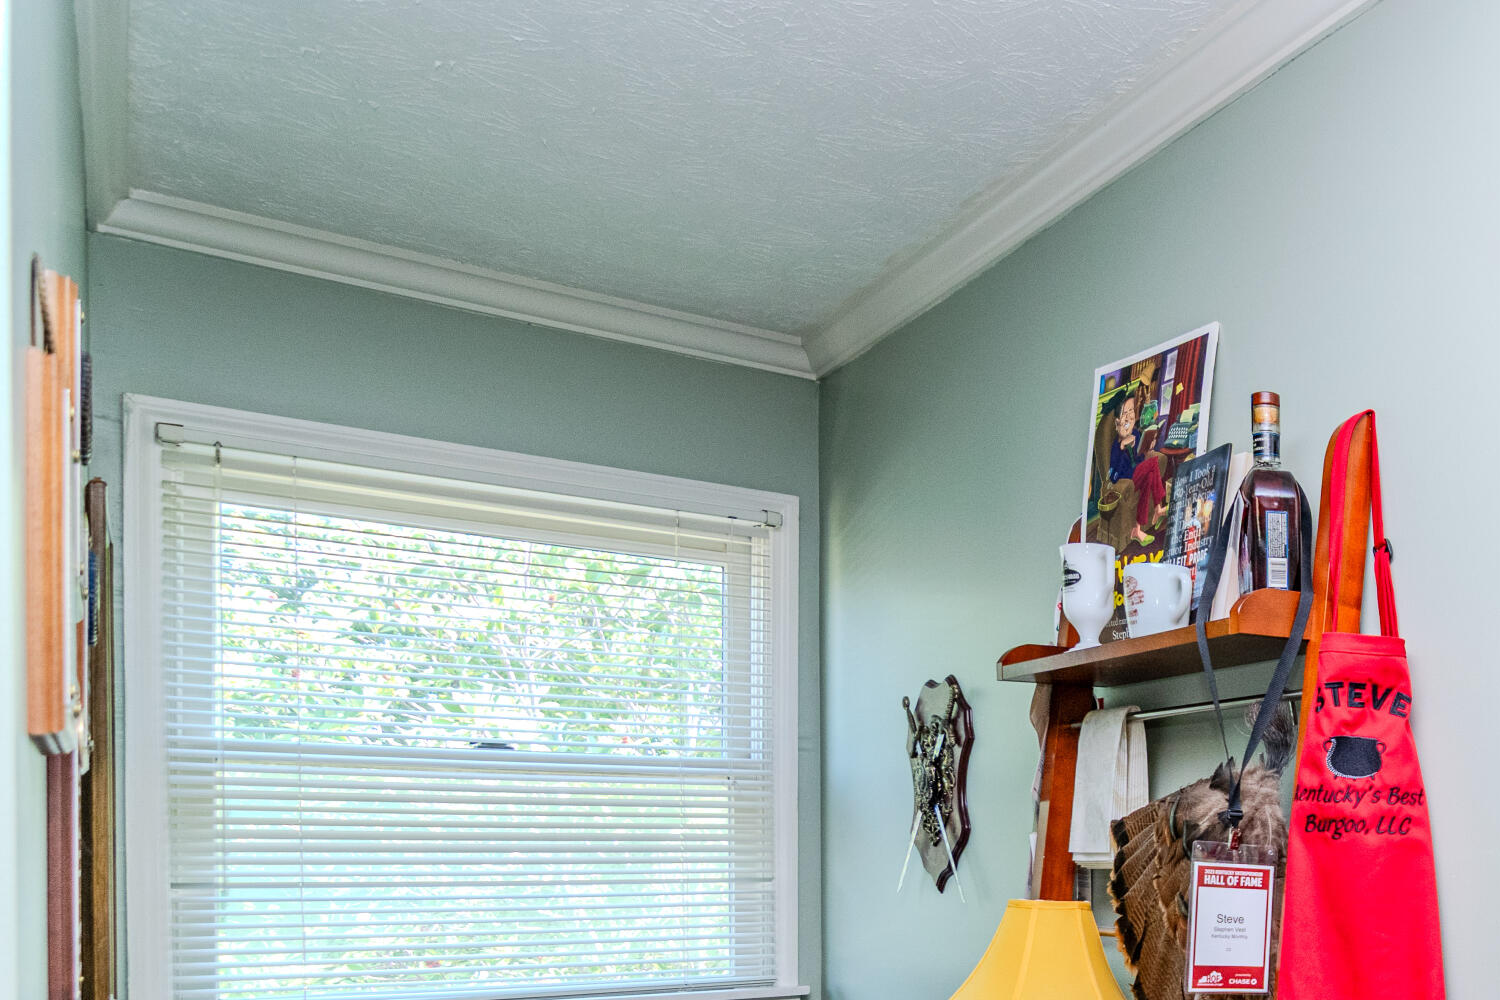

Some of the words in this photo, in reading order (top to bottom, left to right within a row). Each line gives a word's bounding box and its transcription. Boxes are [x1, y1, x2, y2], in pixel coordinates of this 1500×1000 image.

[1387, 787, 1425, 806] Best
[1304, 813, 1371, 840] Burgoo,
[1375, 815, 1413, 835] LLC
[1203, 875, 1226, 886] HALL
[1227, 877, 1239, 886] OF
[1240, 878, 1263, 888] FAME
[1216, 913, 1245, 924] Steve
